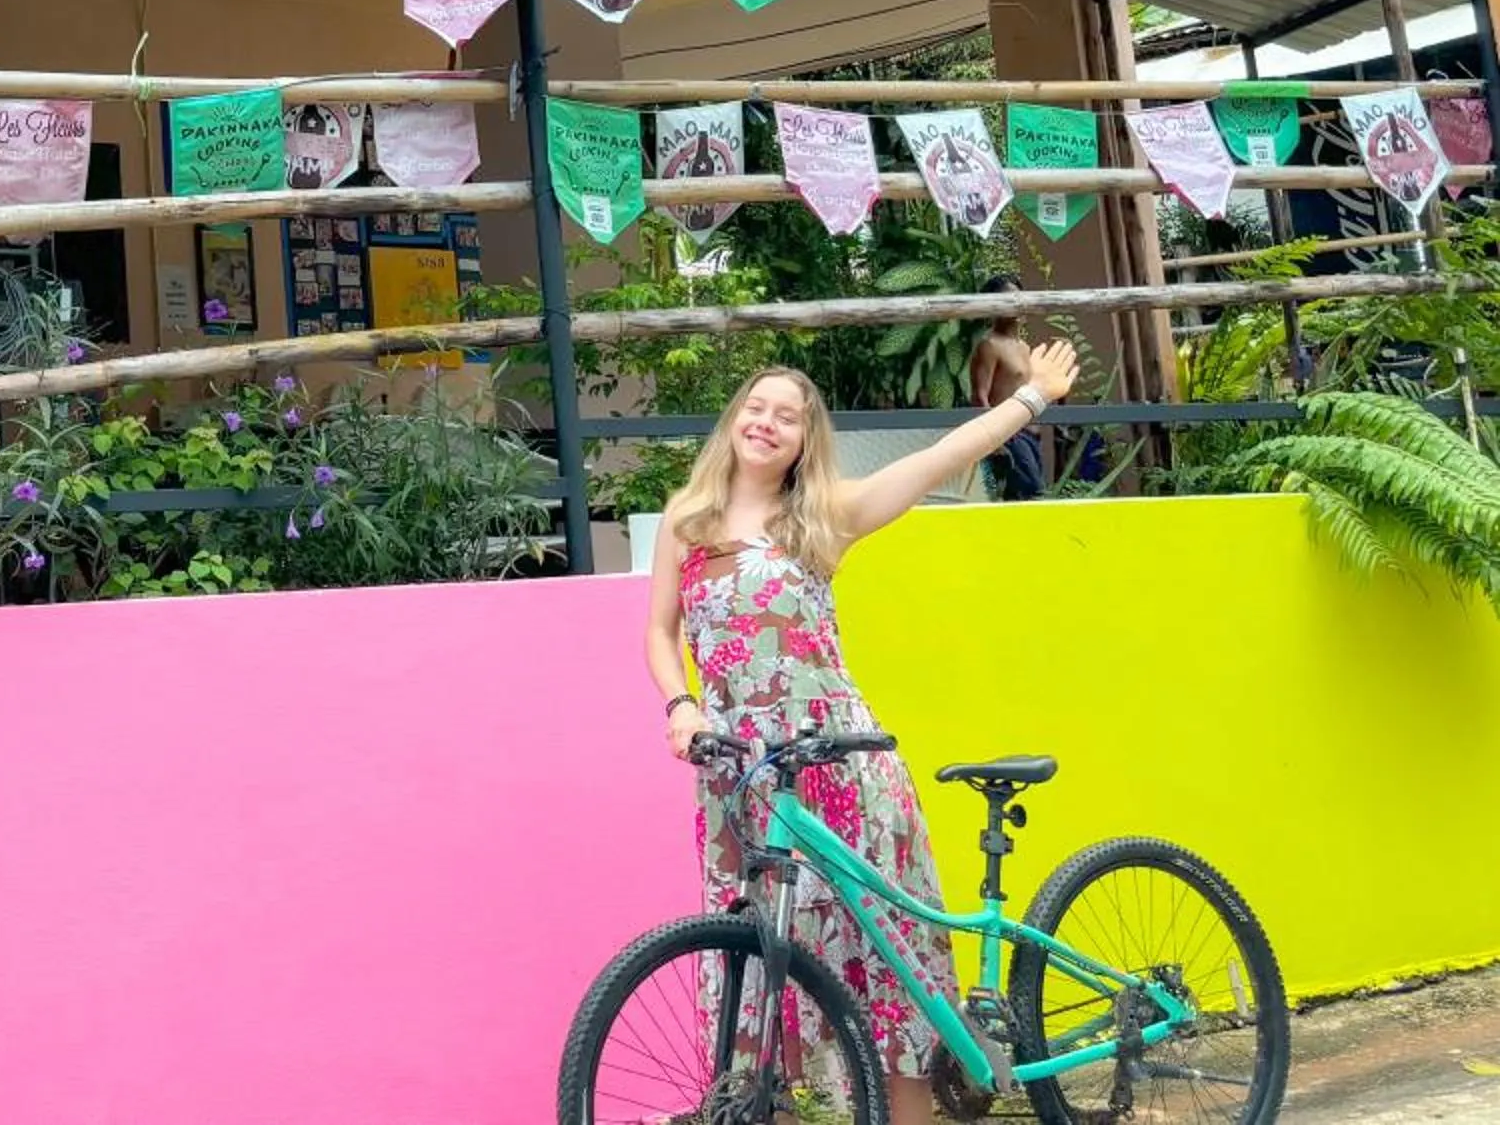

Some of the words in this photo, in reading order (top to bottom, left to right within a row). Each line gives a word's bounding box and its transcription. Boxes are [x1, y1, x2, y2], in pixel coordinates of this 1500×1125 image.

[25, 110, 86, 145] Fleurs
[181, 116, 283, 140] PAKINNAKA
[659, 120, 698, 158] MAO
[709, 120, 740, 152] MAO
[949, 125, 991, 152] MAO
[1354, 104, 1384, 139] MAO
